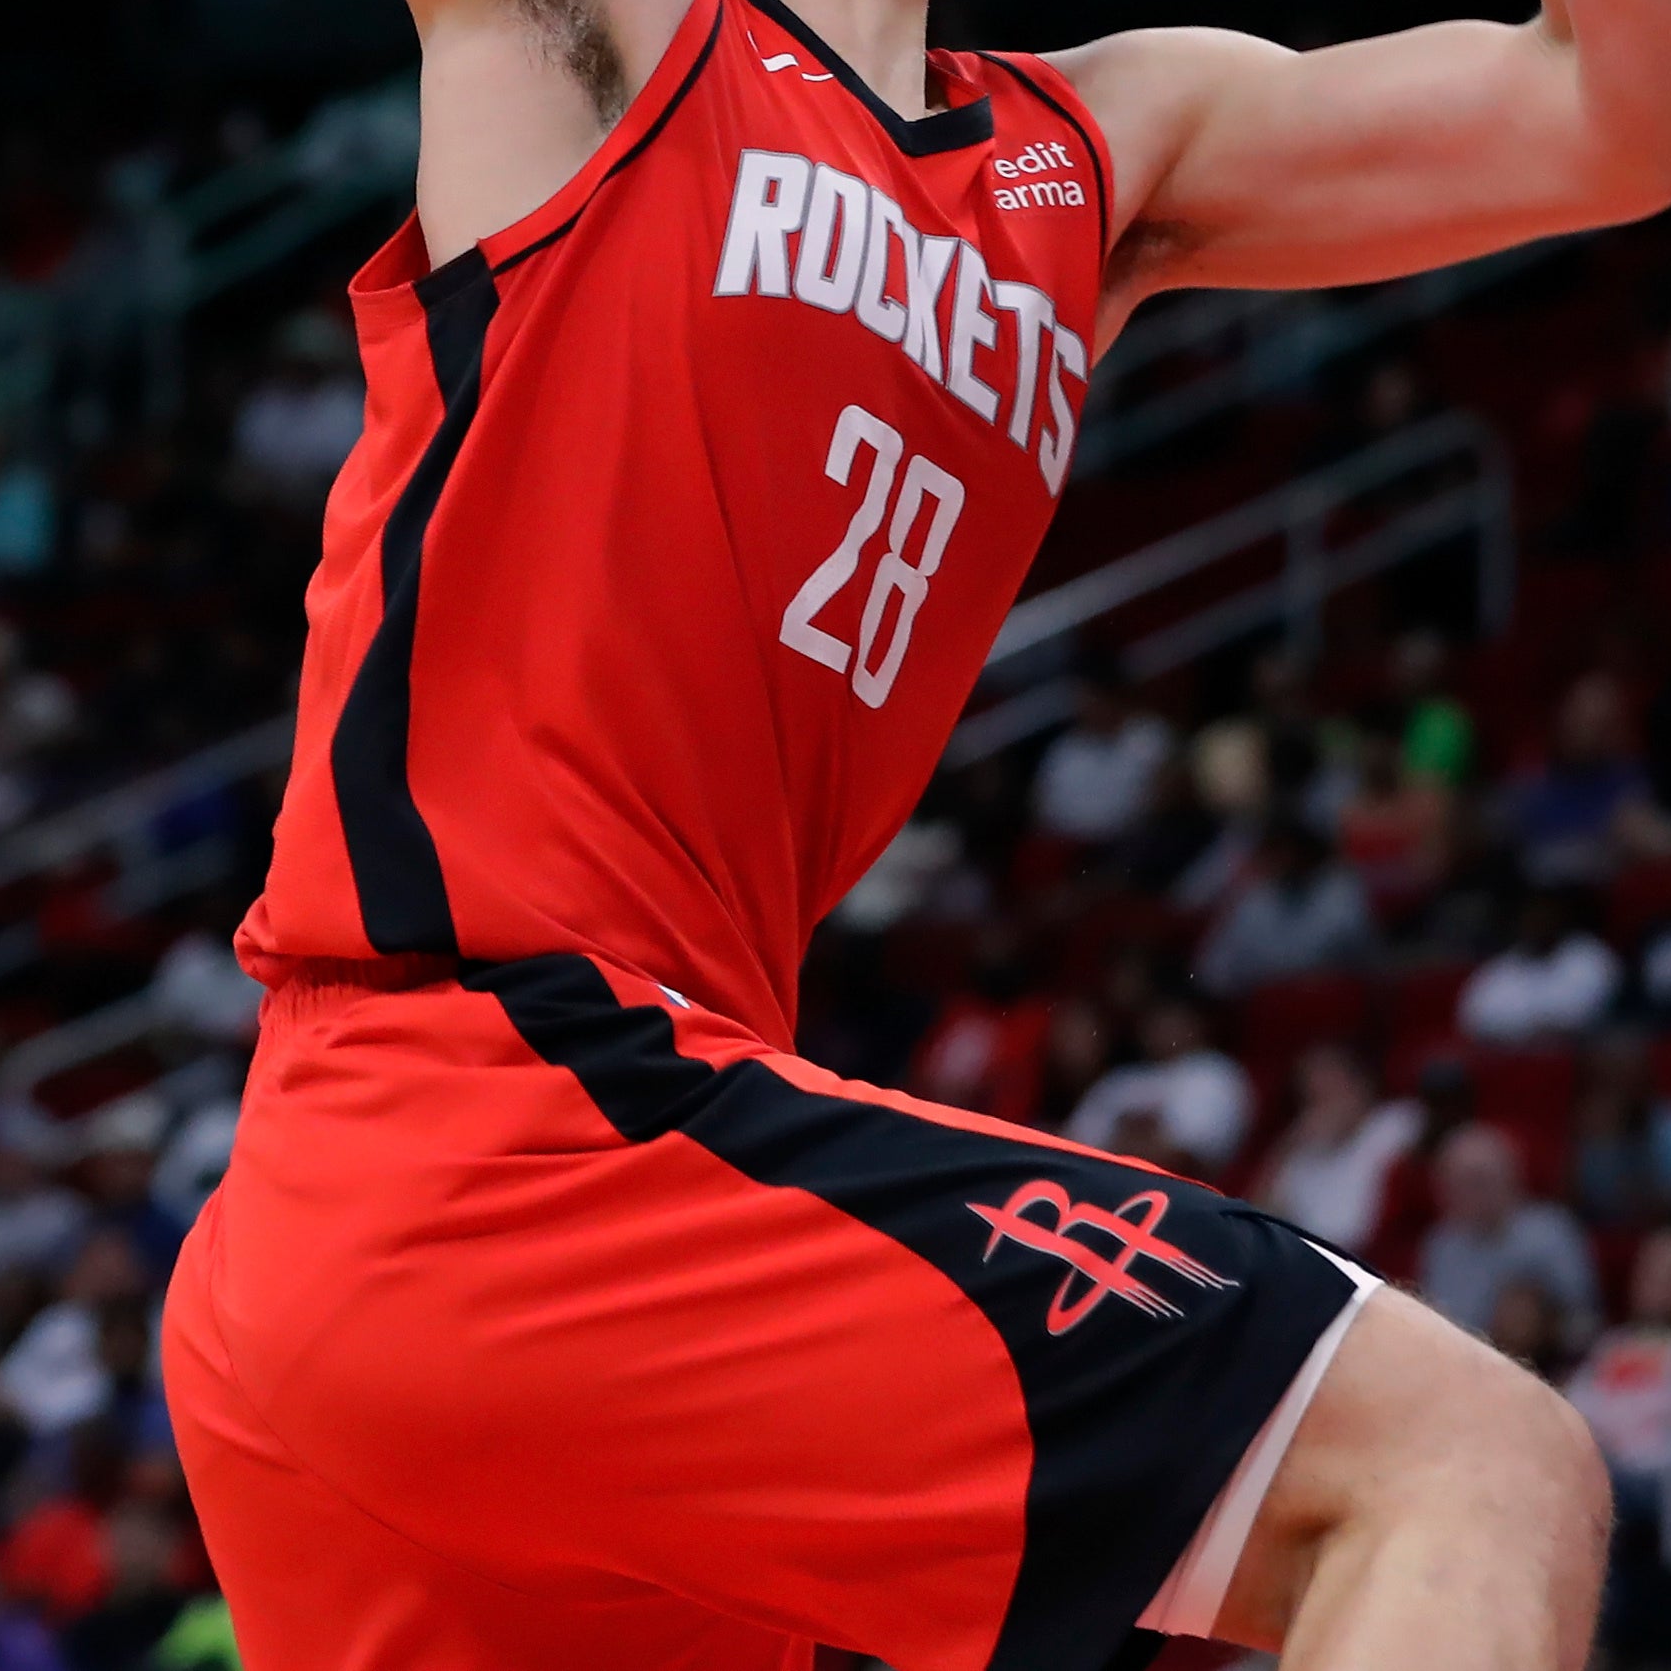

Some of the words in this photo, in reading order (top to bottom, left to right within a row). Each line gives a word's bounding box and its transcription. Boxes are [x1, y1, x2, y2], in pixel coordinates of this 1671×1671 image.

[993, 180, 1086, 210] arma
[994, 141, 1074, 179] edit
[713, 148, 1090, 498] ROCKETS
[779, 404, 965, 709] 28
